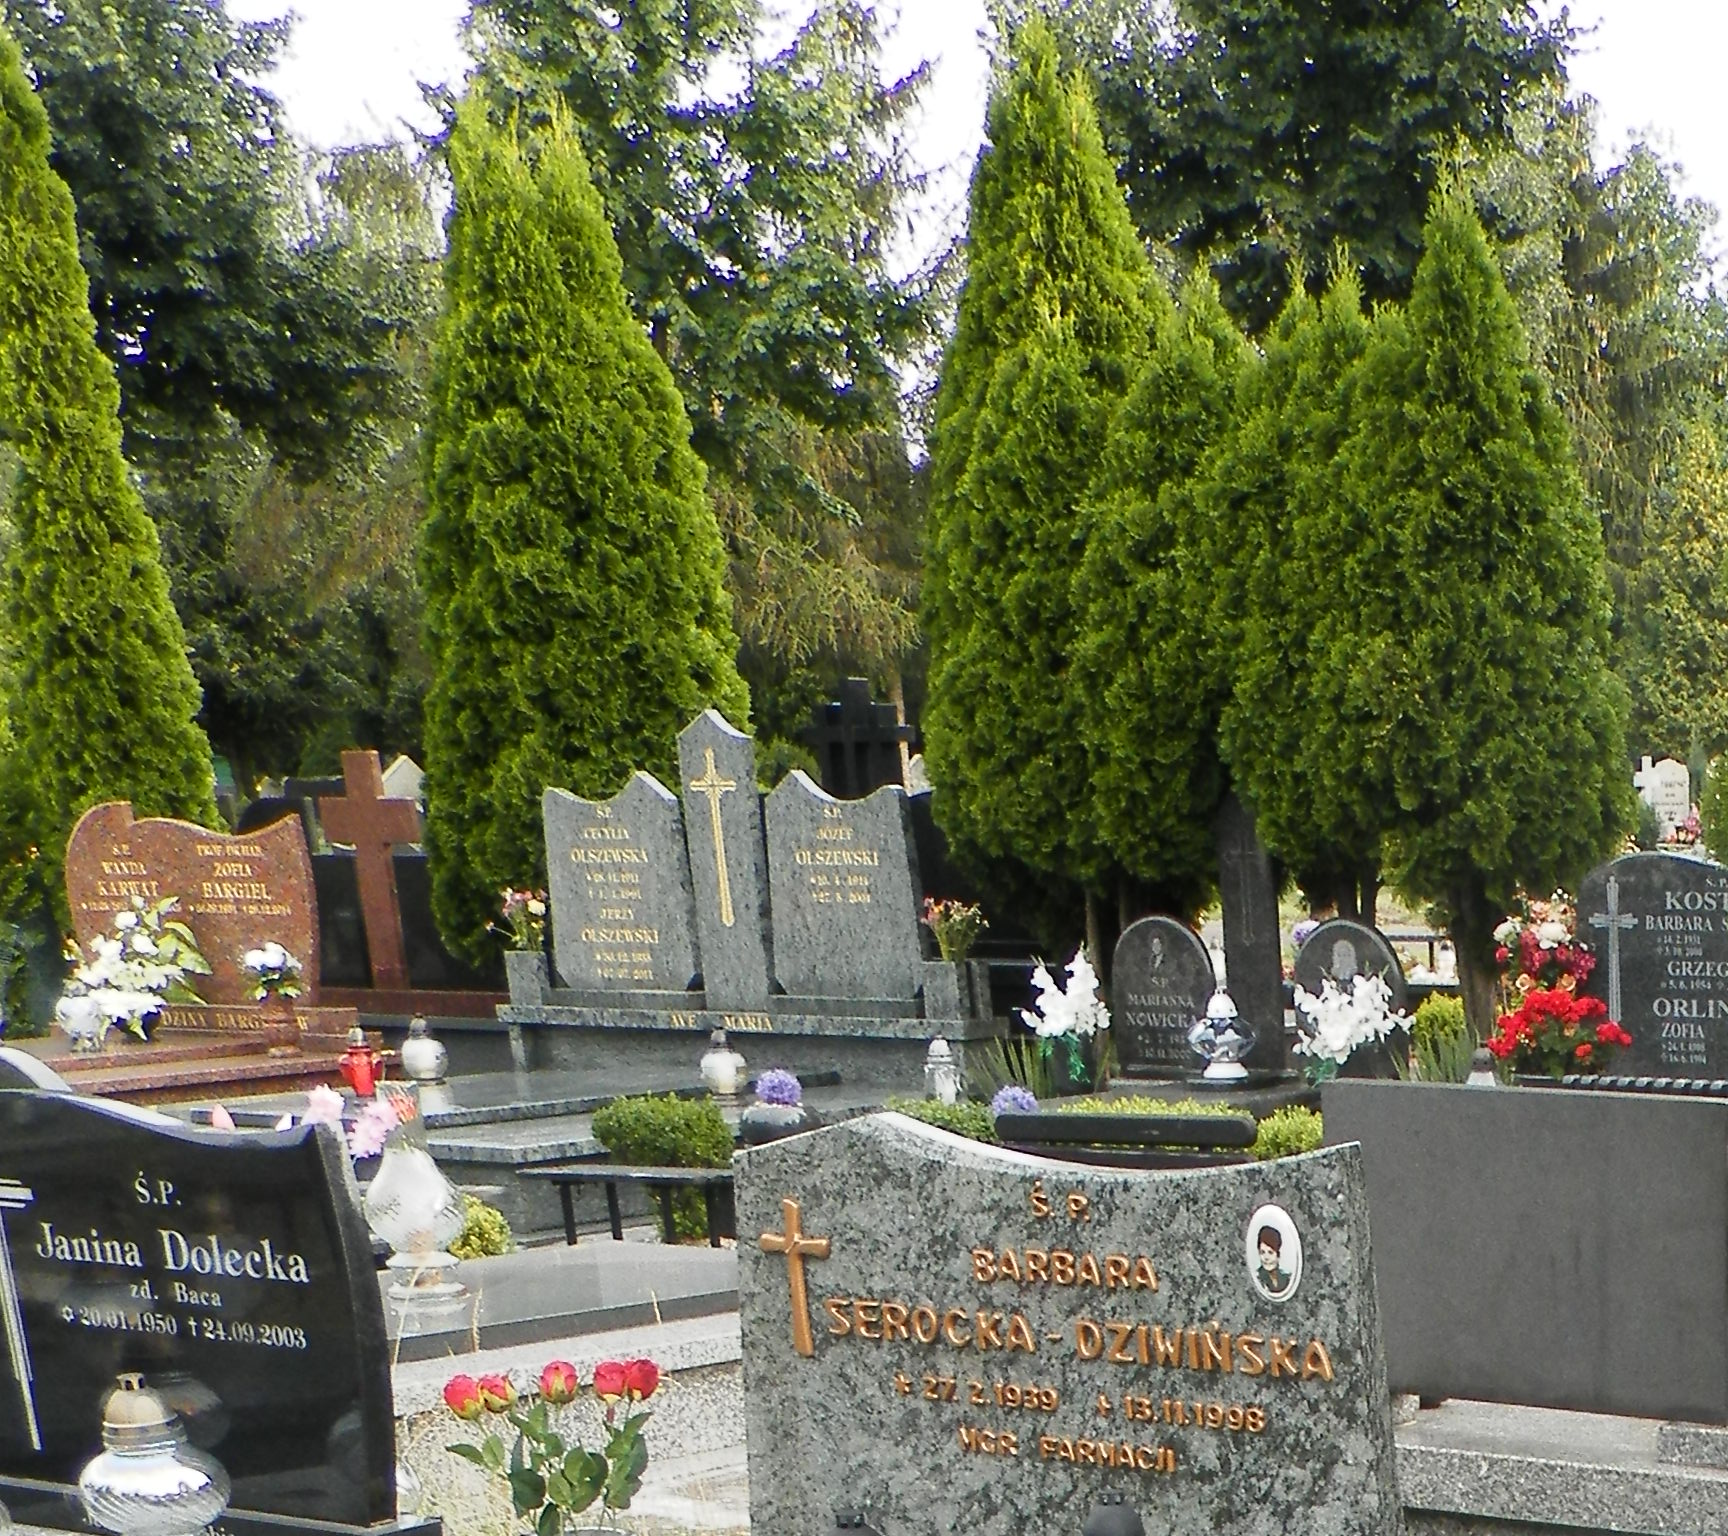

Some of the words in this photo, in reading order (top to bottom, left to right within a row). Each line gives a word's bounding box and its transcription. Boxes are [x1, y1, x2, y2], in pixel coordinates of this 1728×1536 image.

[570, 848, 649, 864] OLSZEWSKA
[794, 849, 879, 867] OLSZEWSKI
[101, 860, 147, 876] WANDA
[97, 881, 160, 898] KARWAT
[202, 881, 272, 900] BARGIEL
[600, 907, 635, 921] JERZY
[1645, 914, 1713, 932] BARBARA
[581, 928, 660, 945] OLSZEWSKI
[1127, 992, 1196, 1009] MARIANNA
[162, 1010, 207, 1028] DZINY
[723, 1013, 773, 1031] MARIA
[1661, 1022, 1706, 1040] ZOFIA
[35, 1221, 144, 1268] Janina
[157, 1228, 311, 1284] Dolecka
[971, 1247, 1161, 1293] BARBARA
[129, 1279, 159, 1301] zd.
[173, 1281, 222, 1307] Baca
[823, 1296, 1037, 1355] SEROCKA
[1073, 1314, 1336, 1383] DZIWIŃSKA
[957, 1423, 1020, 1458] MGR
[1037, 1433, 1178, 1474] FARMACJI
